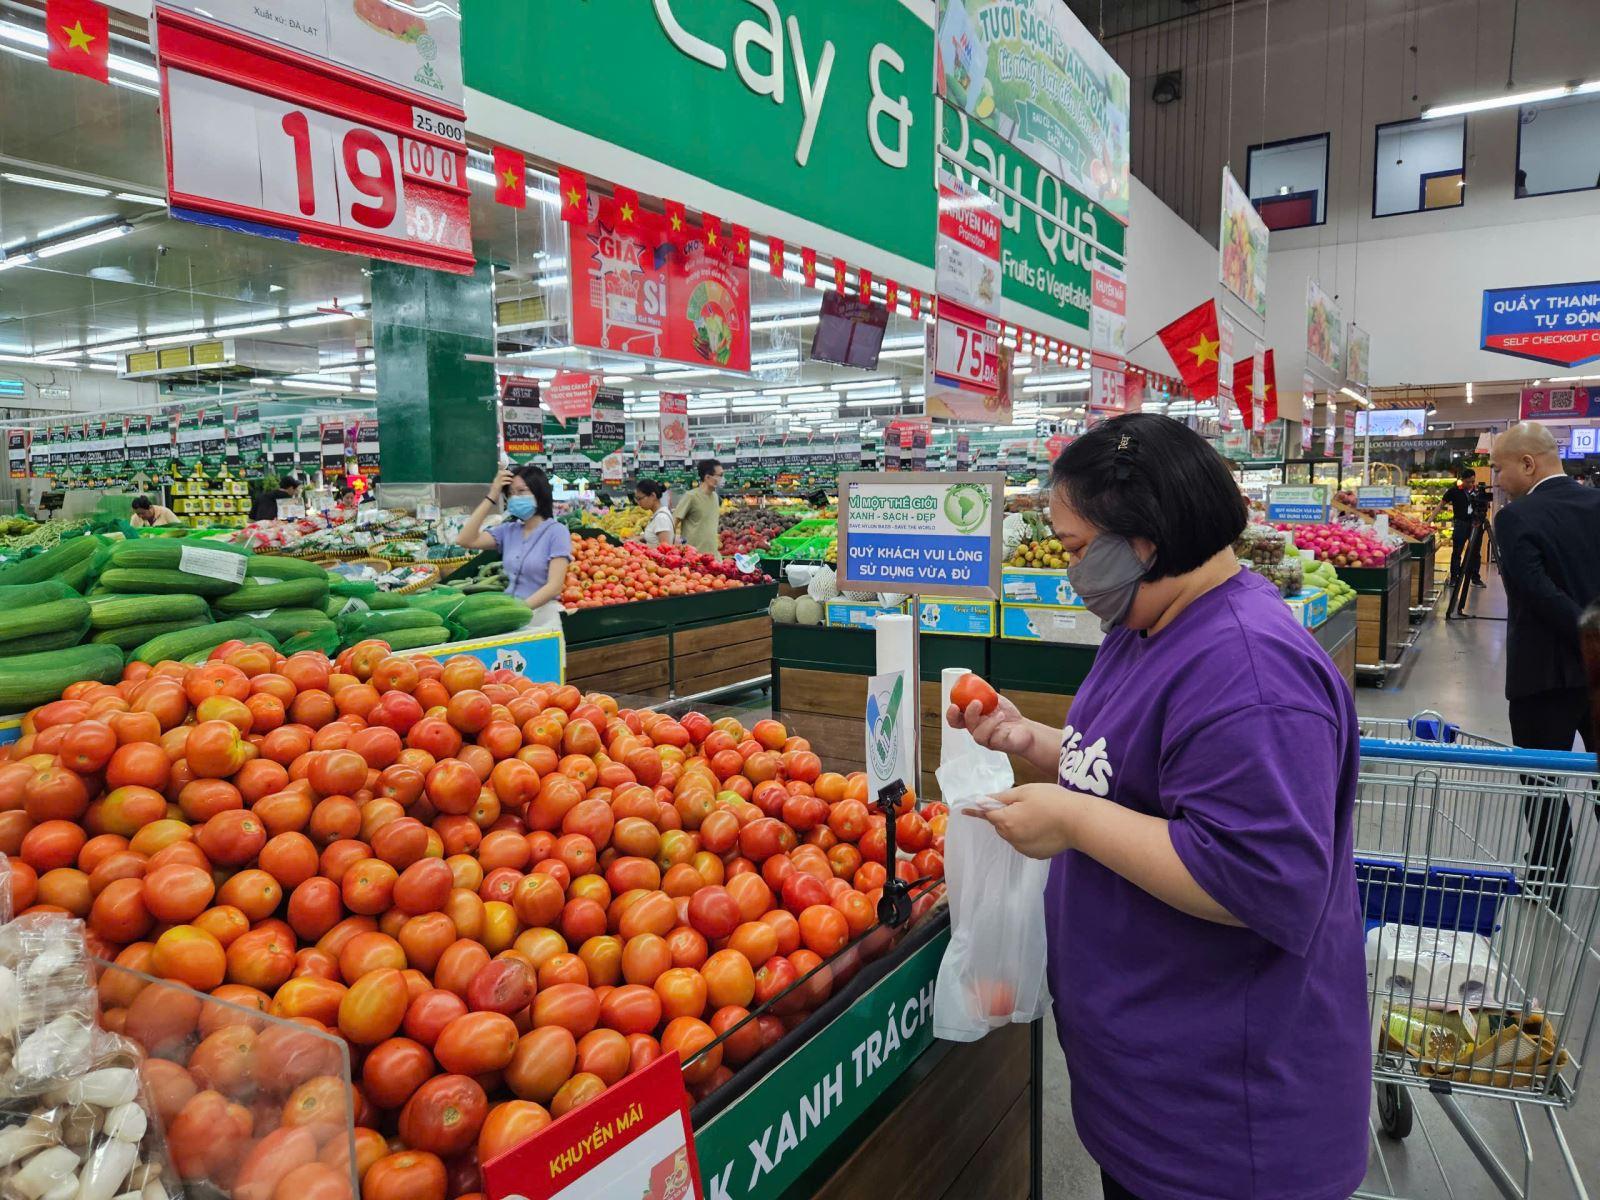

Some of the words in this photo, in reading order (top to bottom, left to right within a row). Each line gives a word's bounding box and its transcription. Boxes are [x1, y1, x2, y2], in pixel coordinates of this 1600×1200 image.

[867, 42, 913, 168] &
[416, 114, 462, 141] 25.000
[282, 110, 397, 229] 19
[409, 140, 452, 183] 000
[958, 225, 986, 249] Promotion
[1002, 250, 1036, 288] Fruits
[1037, 268, 1046, 292] &
[1534, 313, 1559, 329] TỰ
[956, 327, 982, 377] 75
[1503, 337, 1529, 347] SELF
[1532, 333, 1589, 345] CHECKOUT
[1102, 371, 1116, 404] 59
[1577, 436, 1592, 446] 10
[861, 495, 886, 510] MỘT
[912, 495, 938, 509] GIỚI
[849, 512, 875, 520] XANH
[883, 512, 908, 522] SẠCH
[916, 513, 936, 523] ĐẸP
[849, 543, 874, 558] QUÝ
[877, 545, 920, 560] KHÁCH
[924, 549, 945, 561] VUI
[948, 547, 983, 562] LÒNG
[859, 562, 877, 575] SỬ
[880, 566, 914, 581] DỤNG
[918, 564, 947, 579] VỪA
[951, 565, 971, 580] ĐỦ
[748, 1066, 843, 1192] XANH
[851, 979, 935, 1088] TRÁCH
[549, 1119, 614, 1178] KHUYẾN
[616, 1102, 644, 1134] MÃI
